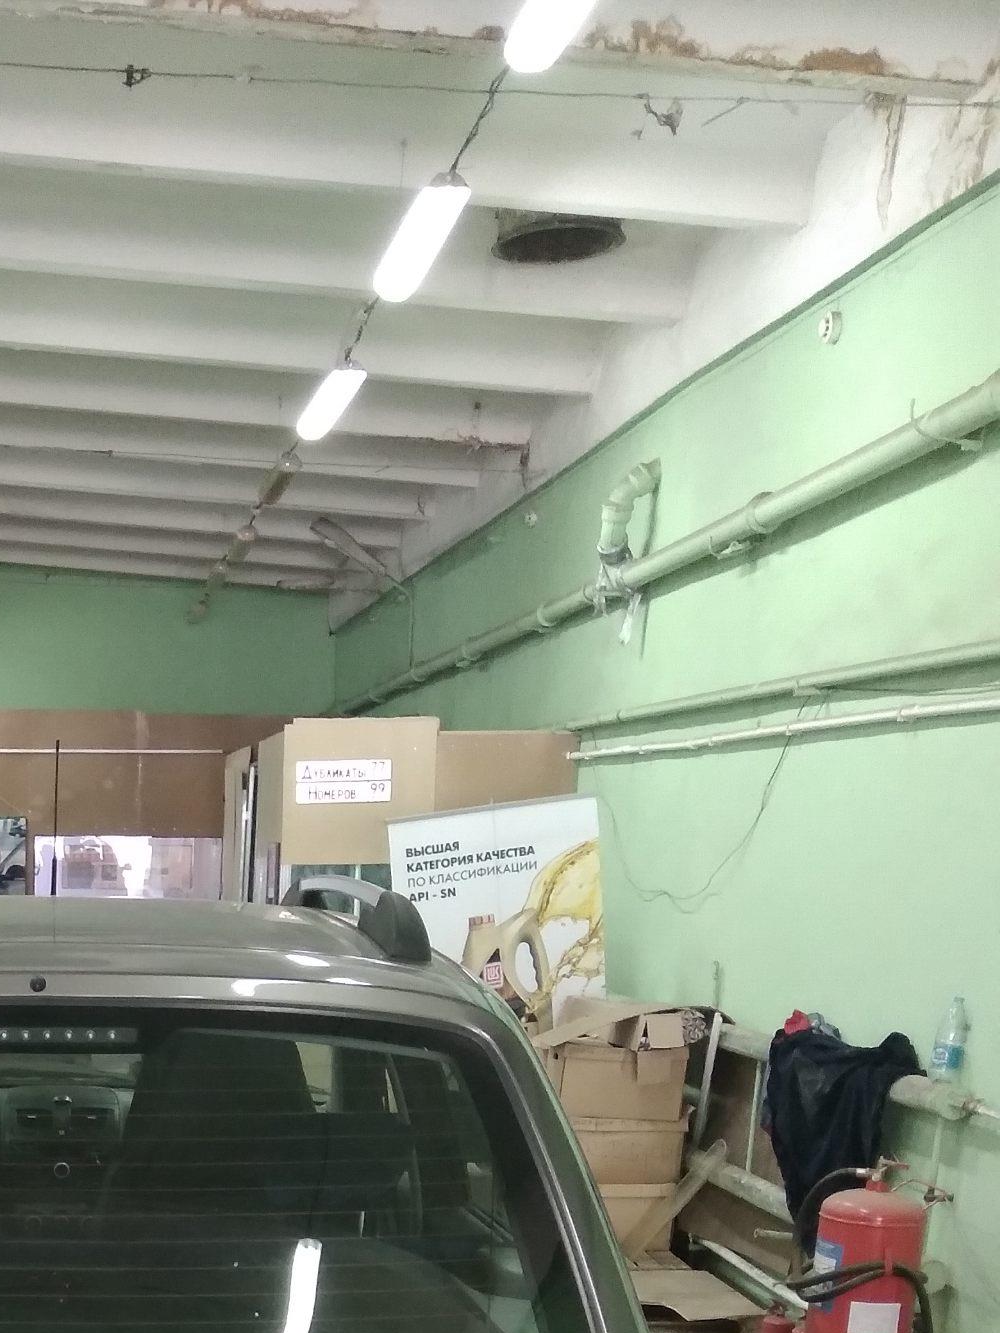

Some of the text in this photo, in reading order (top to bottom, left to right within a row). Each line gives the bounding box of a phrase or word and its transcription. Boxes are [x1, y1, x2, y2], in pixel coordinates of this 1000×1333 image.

[405, 841, 460, 858] ВЫСШАЯ
[406, 845, 536, 873] КАТЕГОРИЯ КАЧЕСТВА
[407, 861, 538, 888] ПО КЛАССИФИКАЦИИ
[409, 891, 429, 902] API
[440, 887, 457, 899] SN
